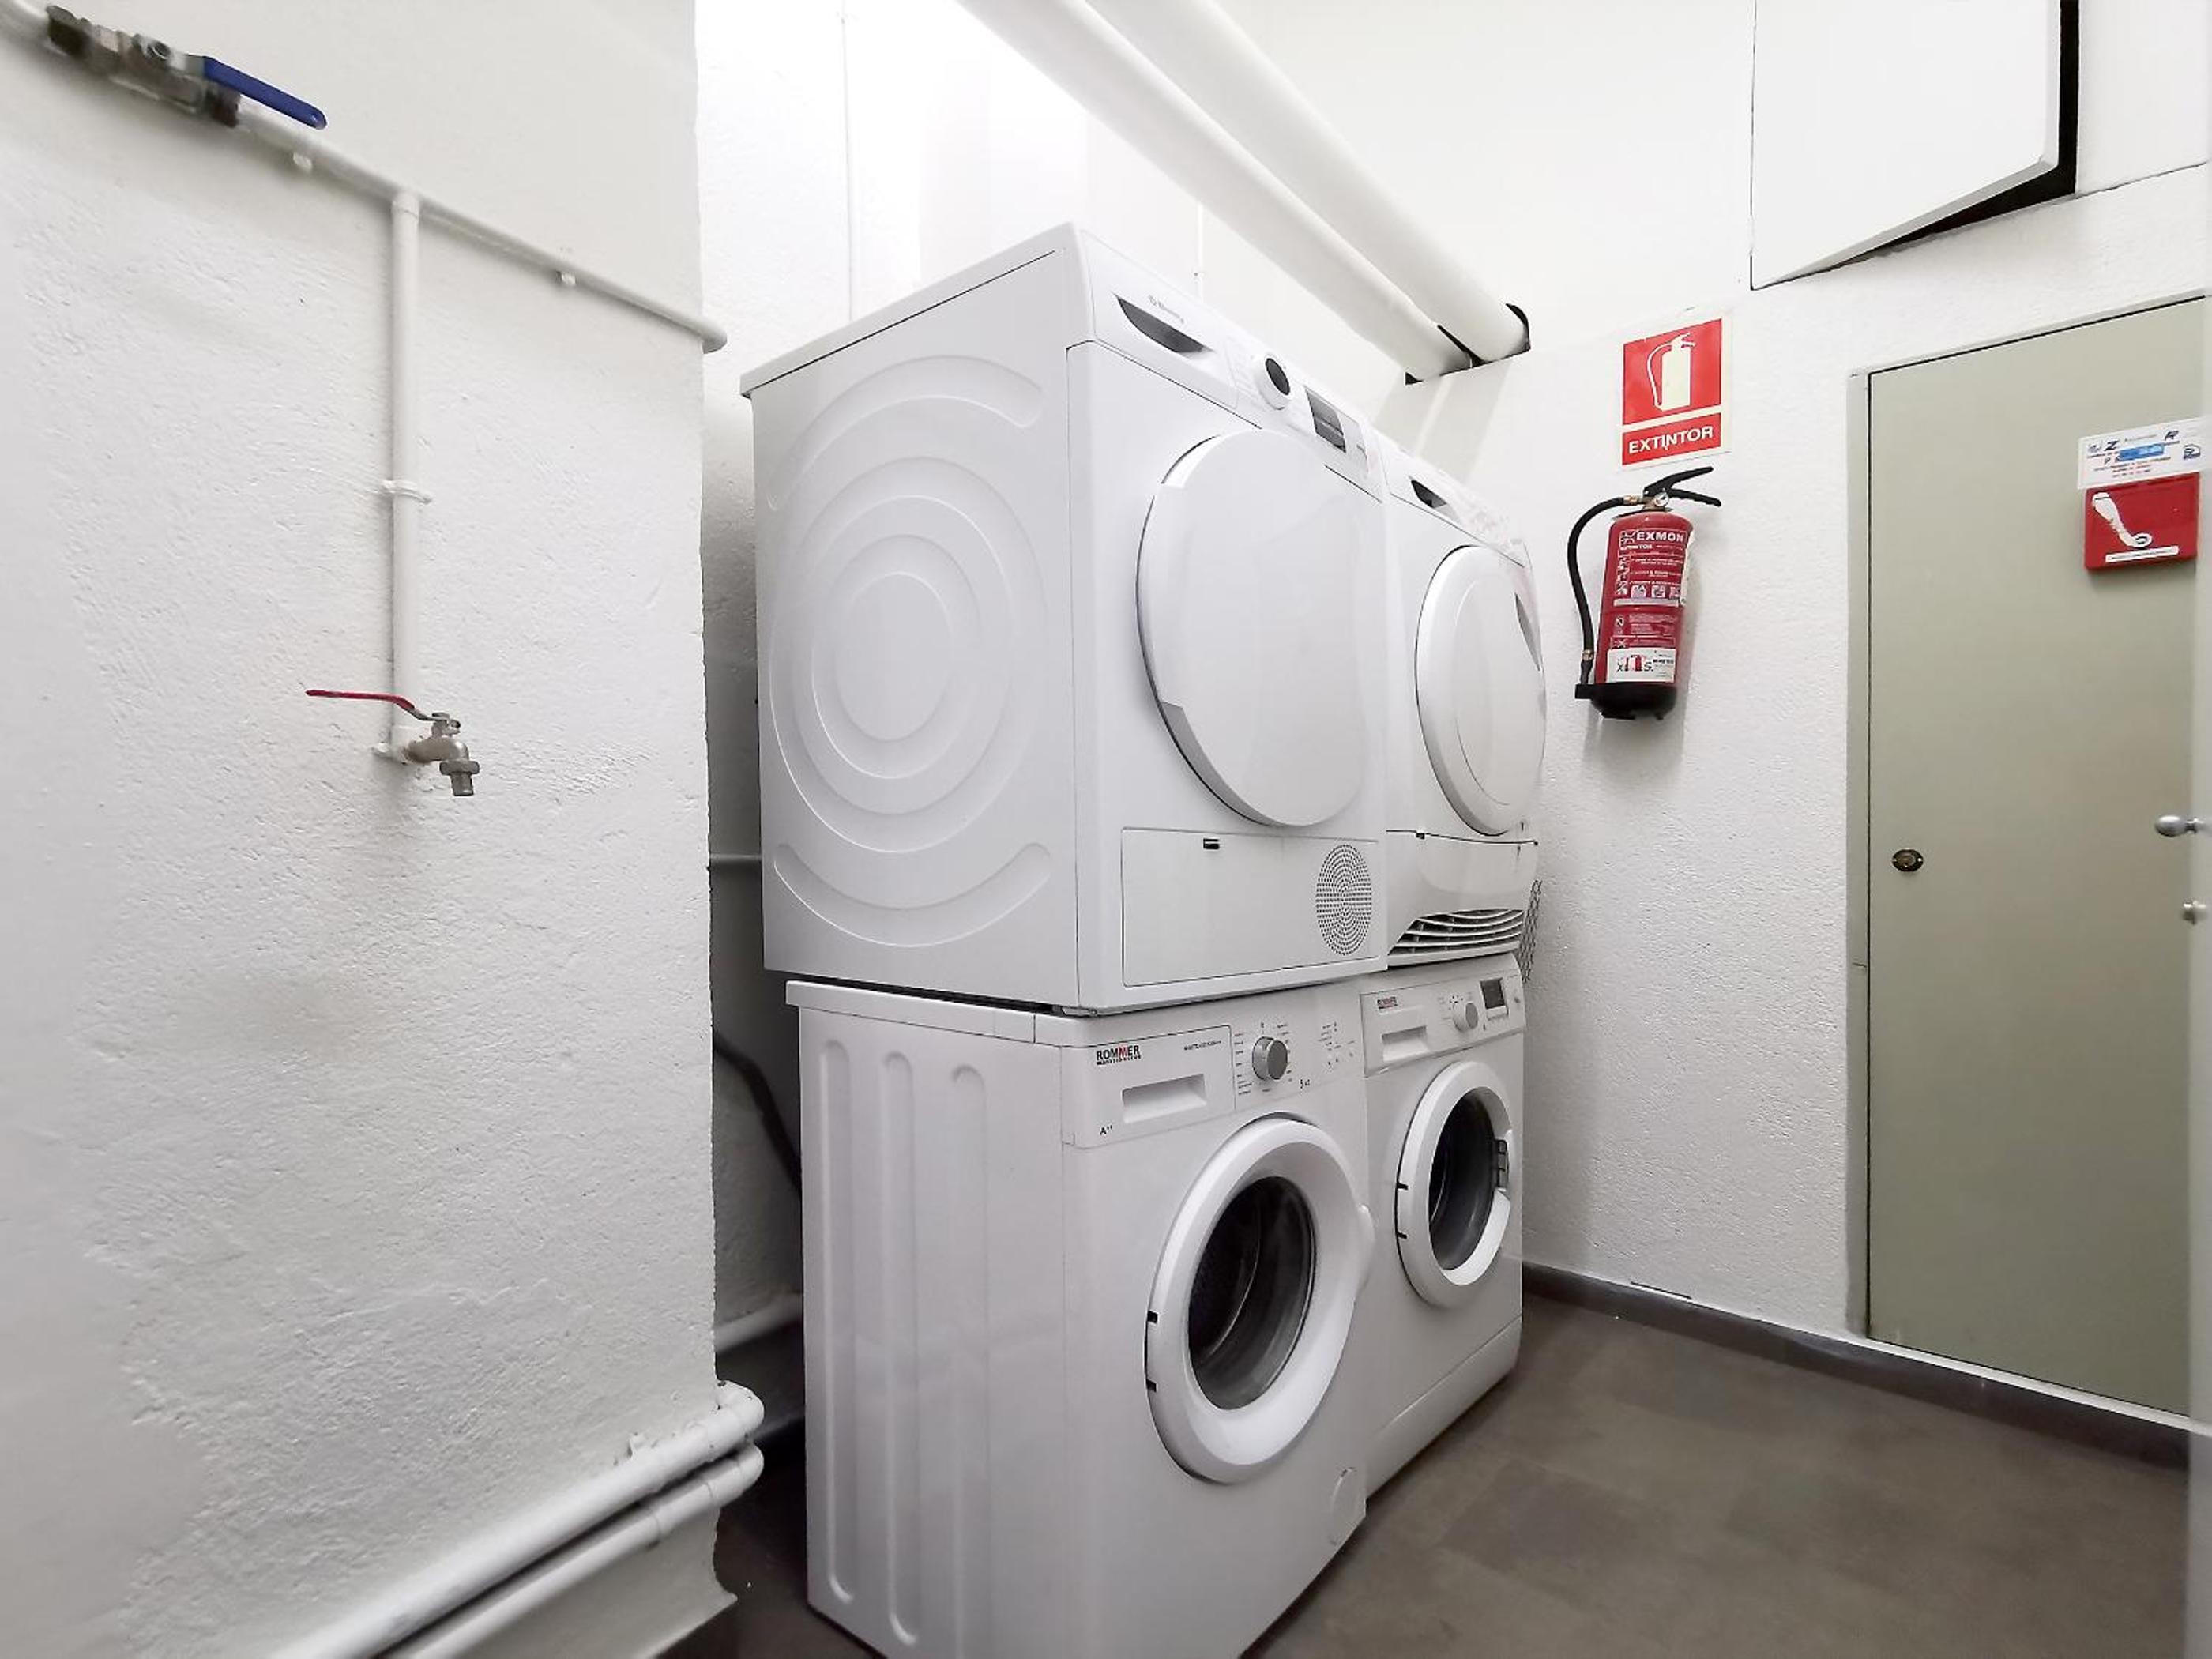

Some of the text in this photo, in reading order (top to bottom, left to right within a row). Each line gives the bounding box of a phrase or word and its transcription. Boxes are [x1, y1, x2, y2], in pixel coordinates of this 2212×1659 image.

[1628, 425, 1714, 454] EXTINTOR
[1636, 531, 1683, 543] EXMON
[1096, 1045, 1139, 1060] ROMMER
